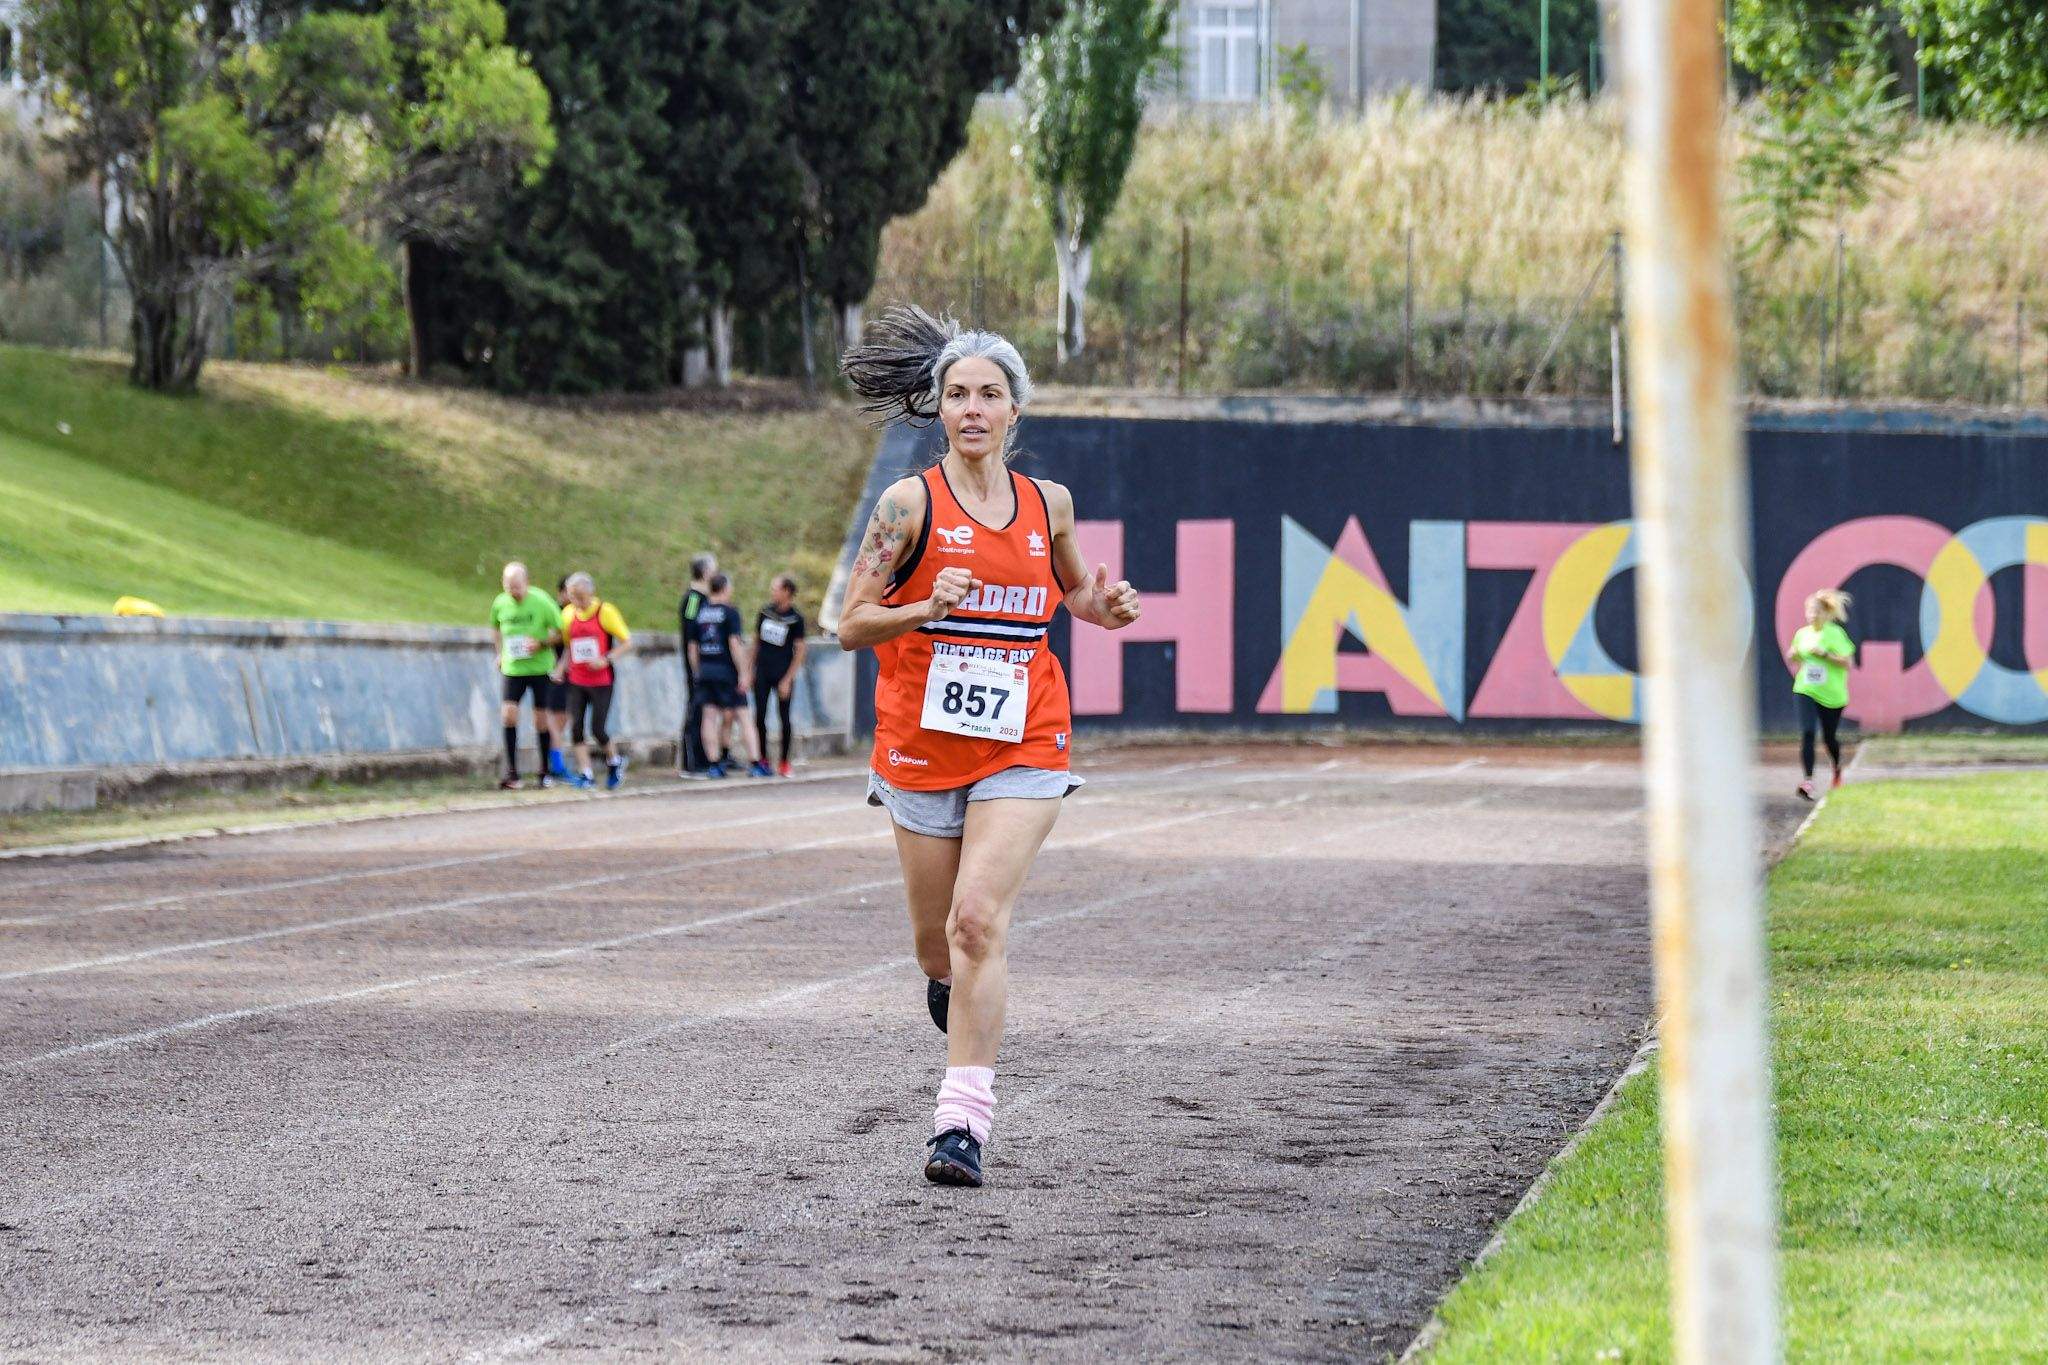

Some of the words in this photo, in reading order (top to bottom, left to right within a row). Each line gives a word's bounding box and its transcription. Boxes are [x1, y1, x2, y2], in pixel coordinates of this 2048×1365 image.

[957, 584, 1048, 617] ADRI
[942, 681, 1010, 720] 857
[999, 726, 1019, 737] 2023
